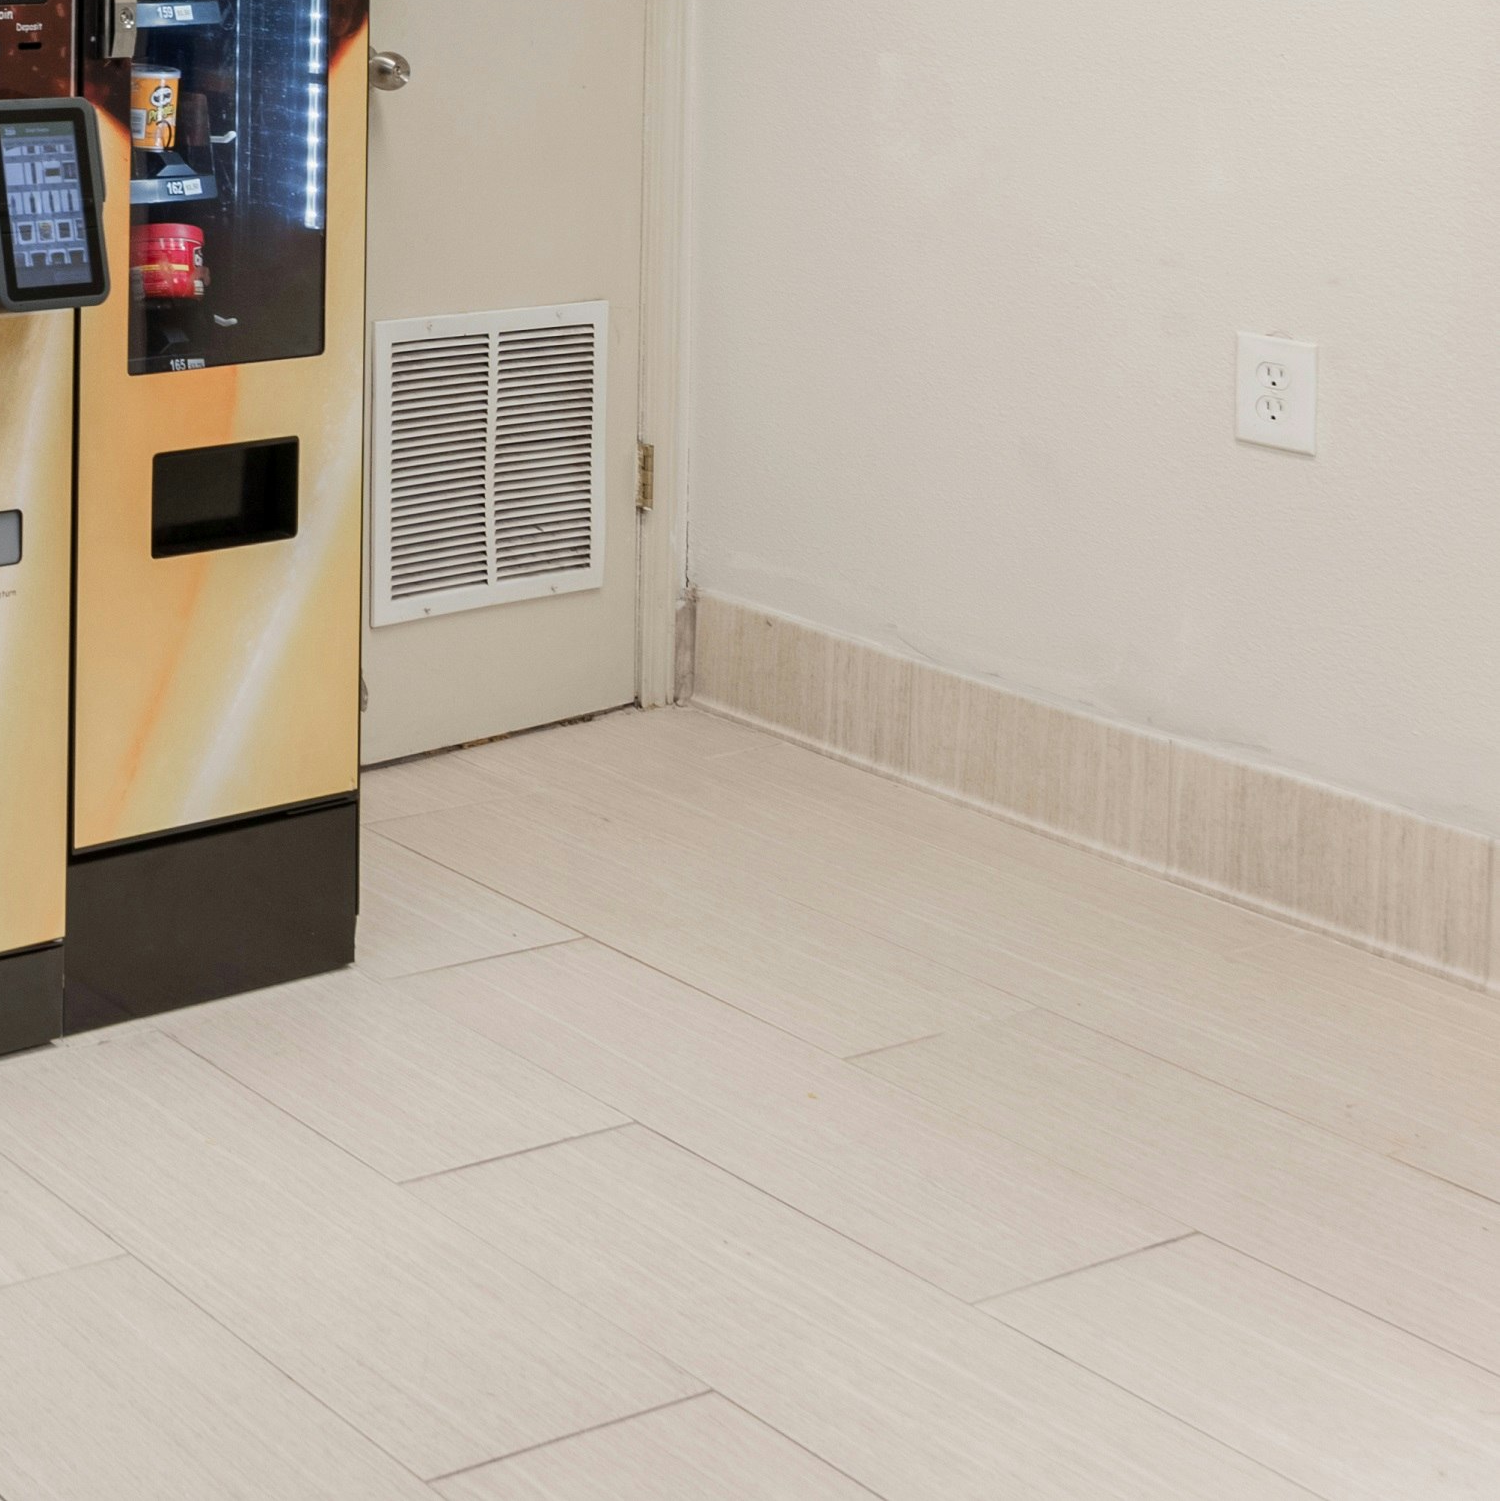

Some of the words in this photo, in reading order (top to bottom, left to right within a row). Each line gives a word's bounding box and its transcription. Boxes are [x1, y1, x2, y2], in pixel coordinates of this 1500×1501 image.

[157, 6, 173, 19] 159
[16, 22, 43, 33] Deposit
[167, 181, 183, 194] 162
[170, 358, 186, 371] 165
